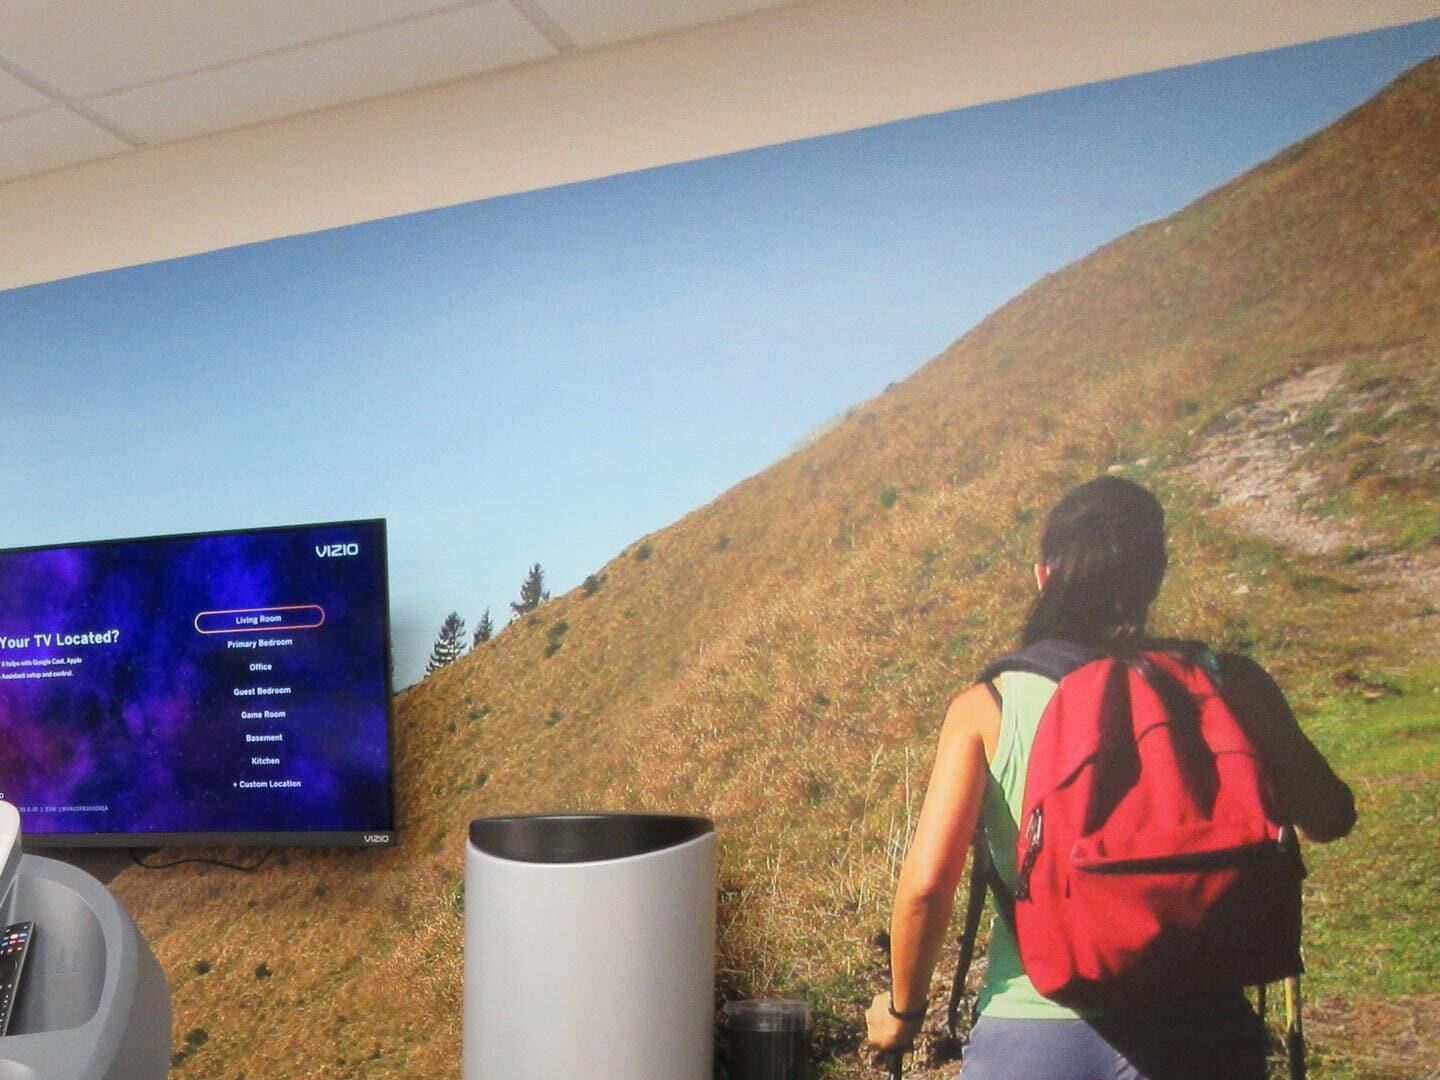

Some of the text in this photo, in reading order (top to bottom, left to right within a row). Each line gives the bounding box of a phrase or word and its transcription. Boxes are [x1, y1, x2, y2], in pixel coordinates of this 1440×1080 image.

[315, 543, 359, 558] VIZIO
[236, 615, 282, 625] Living Room
[33, 633, 52, 648] TV
[56, 629, 120, 647] Located?
[227, 638, 293, 649] Primary Bedroom
[33, 659, 51, 667] Google
[67, 656, 83, 665] Apple
[249, 663, 273, 671] Office
[233, 687, 292, 696] Guest Bedroom
[241, 710, 286, 719] Game Room
[246, 734, 283, 742] Basement
[251, 757, 280, 765] Kitchen
[239, 780, 268, 788] Custom
[269, 780, 302, 788] Location
[363, 834, 390, 843] VIZIO
